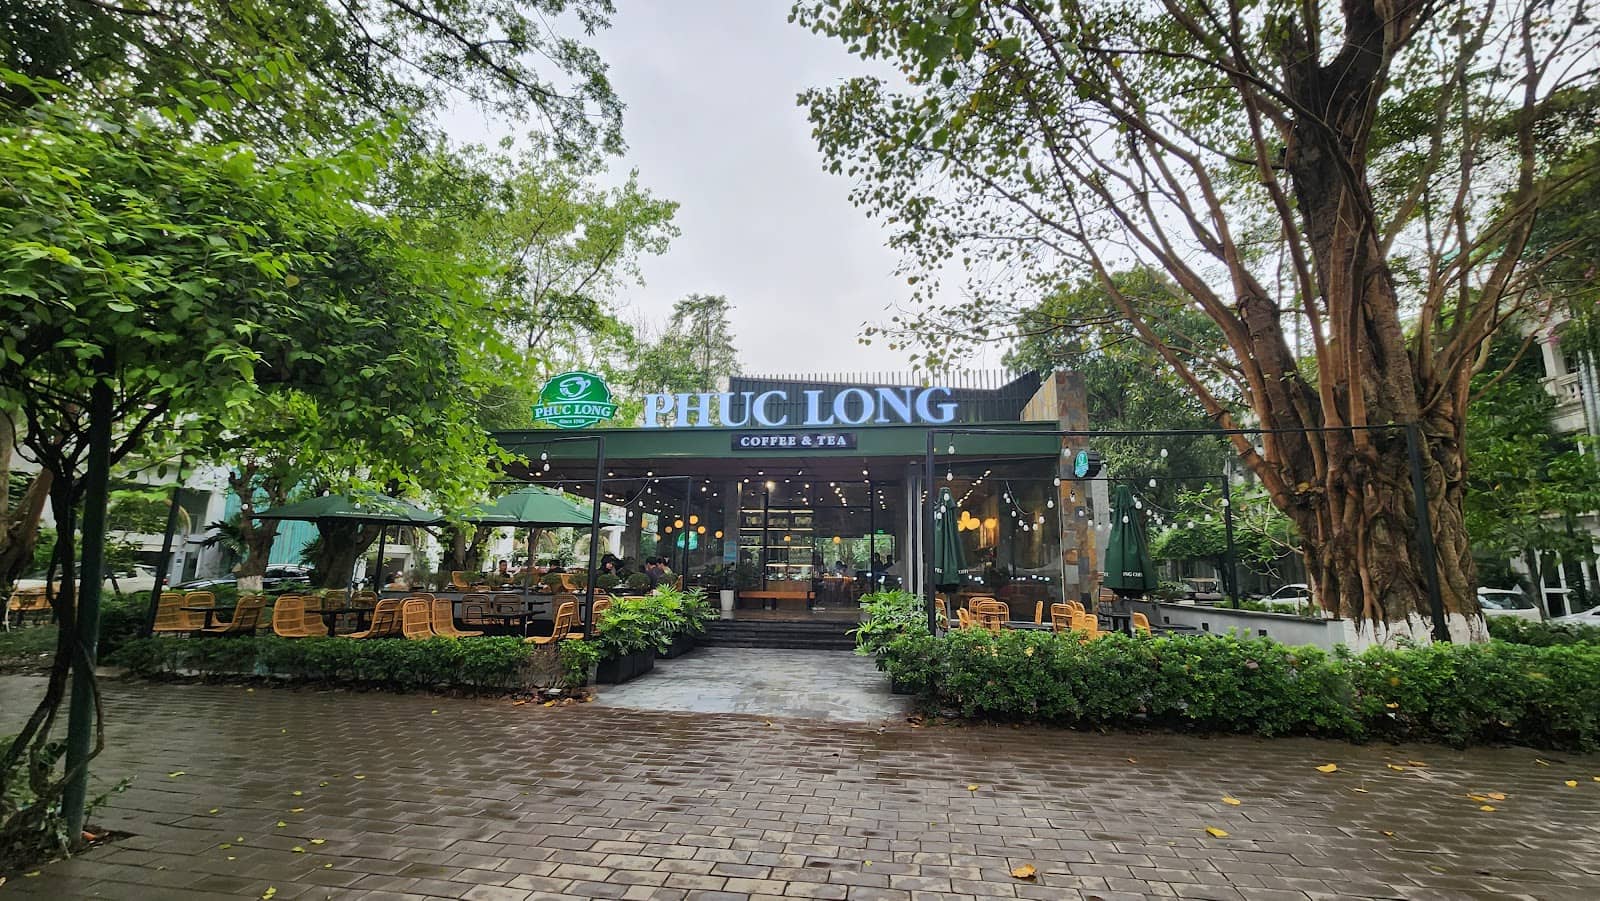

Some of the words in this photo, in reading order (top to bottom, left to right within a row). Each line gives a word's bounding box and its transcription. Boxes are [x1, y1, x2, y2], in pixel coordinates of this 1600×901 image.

[535, 405, 571, 418] PHUC
[574, 405, 611, 417] LONG
[643, 390, 788, 428] PHUC
[803, 386, 959, 425] LONG
[740, 436, 797, 447] COFFEE
[801, 435, 812, 446] &
[816, 435, 847, 446] TEA
